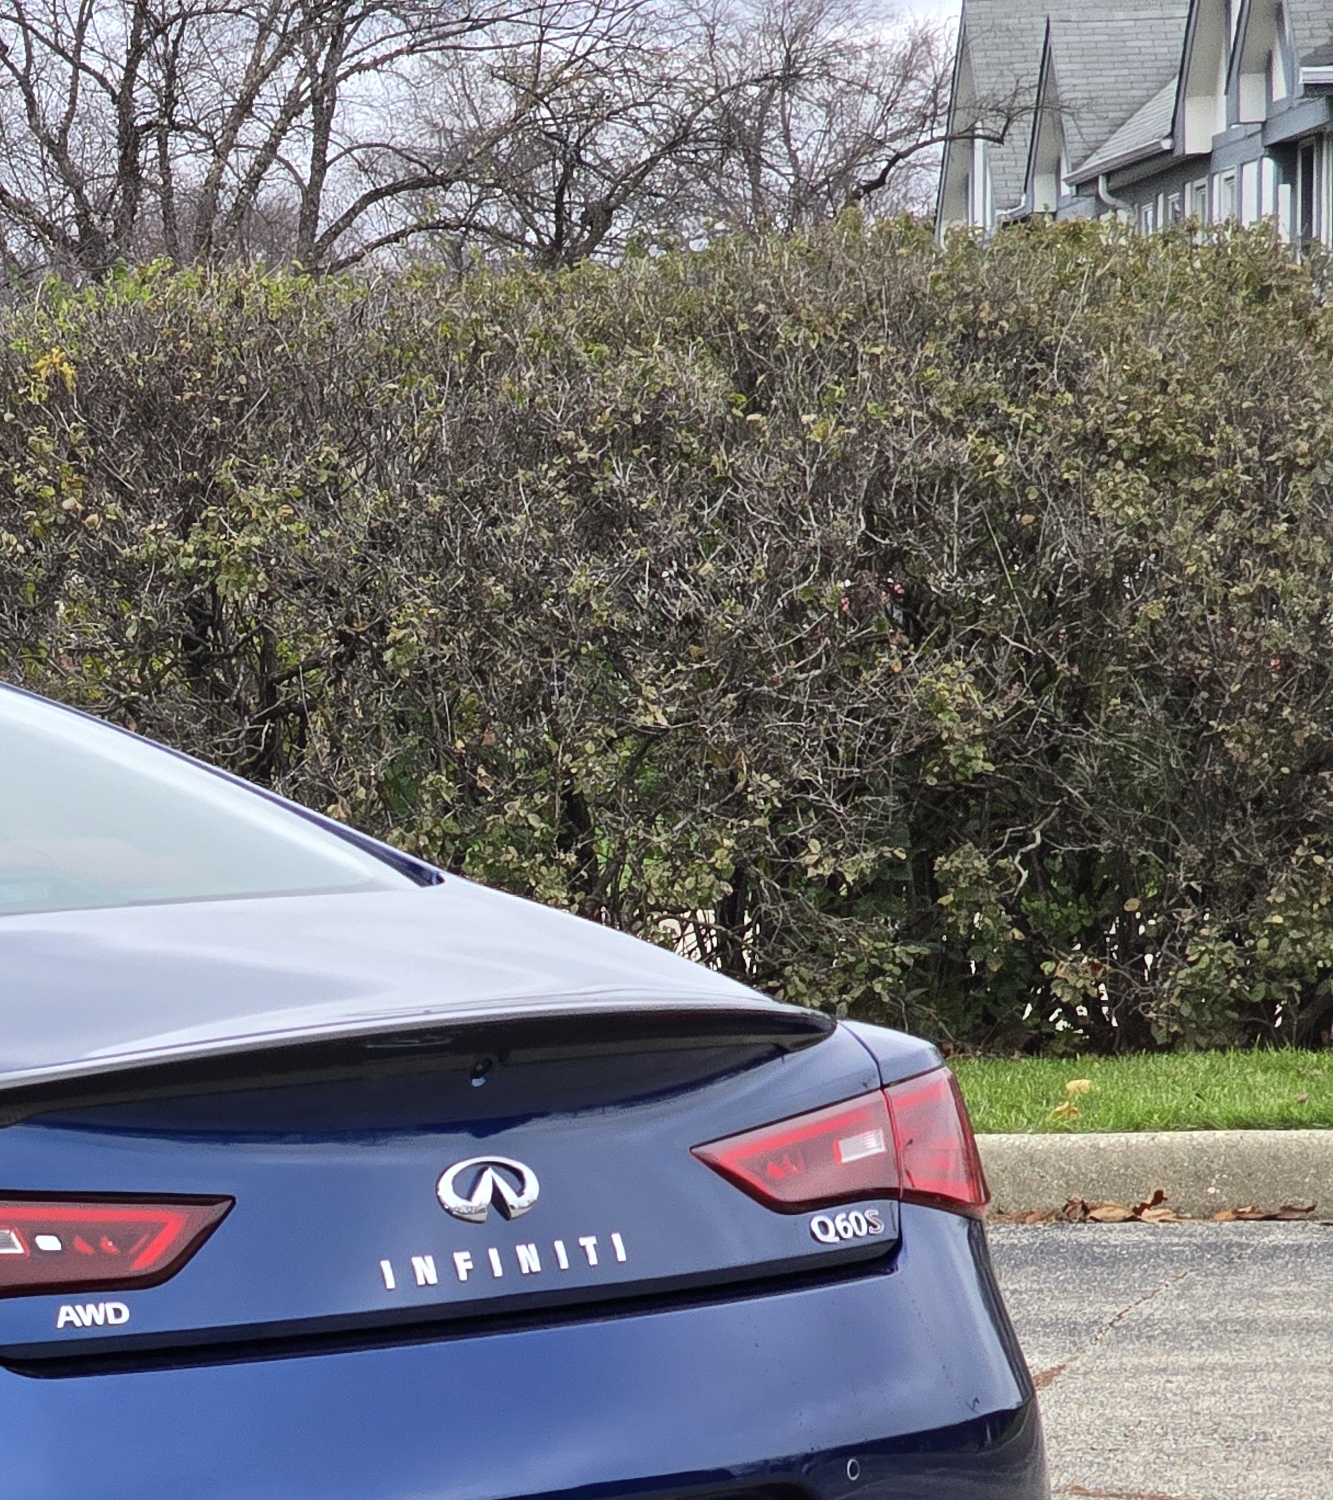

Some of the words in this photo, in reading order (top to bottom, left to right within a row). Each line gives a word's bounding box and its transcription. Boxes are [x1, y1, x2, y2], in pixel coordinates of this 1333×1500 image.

[810, 1209, 885, 1243] Q60S
[380, 1232, 627, 1290] INFINITI
[56, 1301, 130, 1329] AWD
